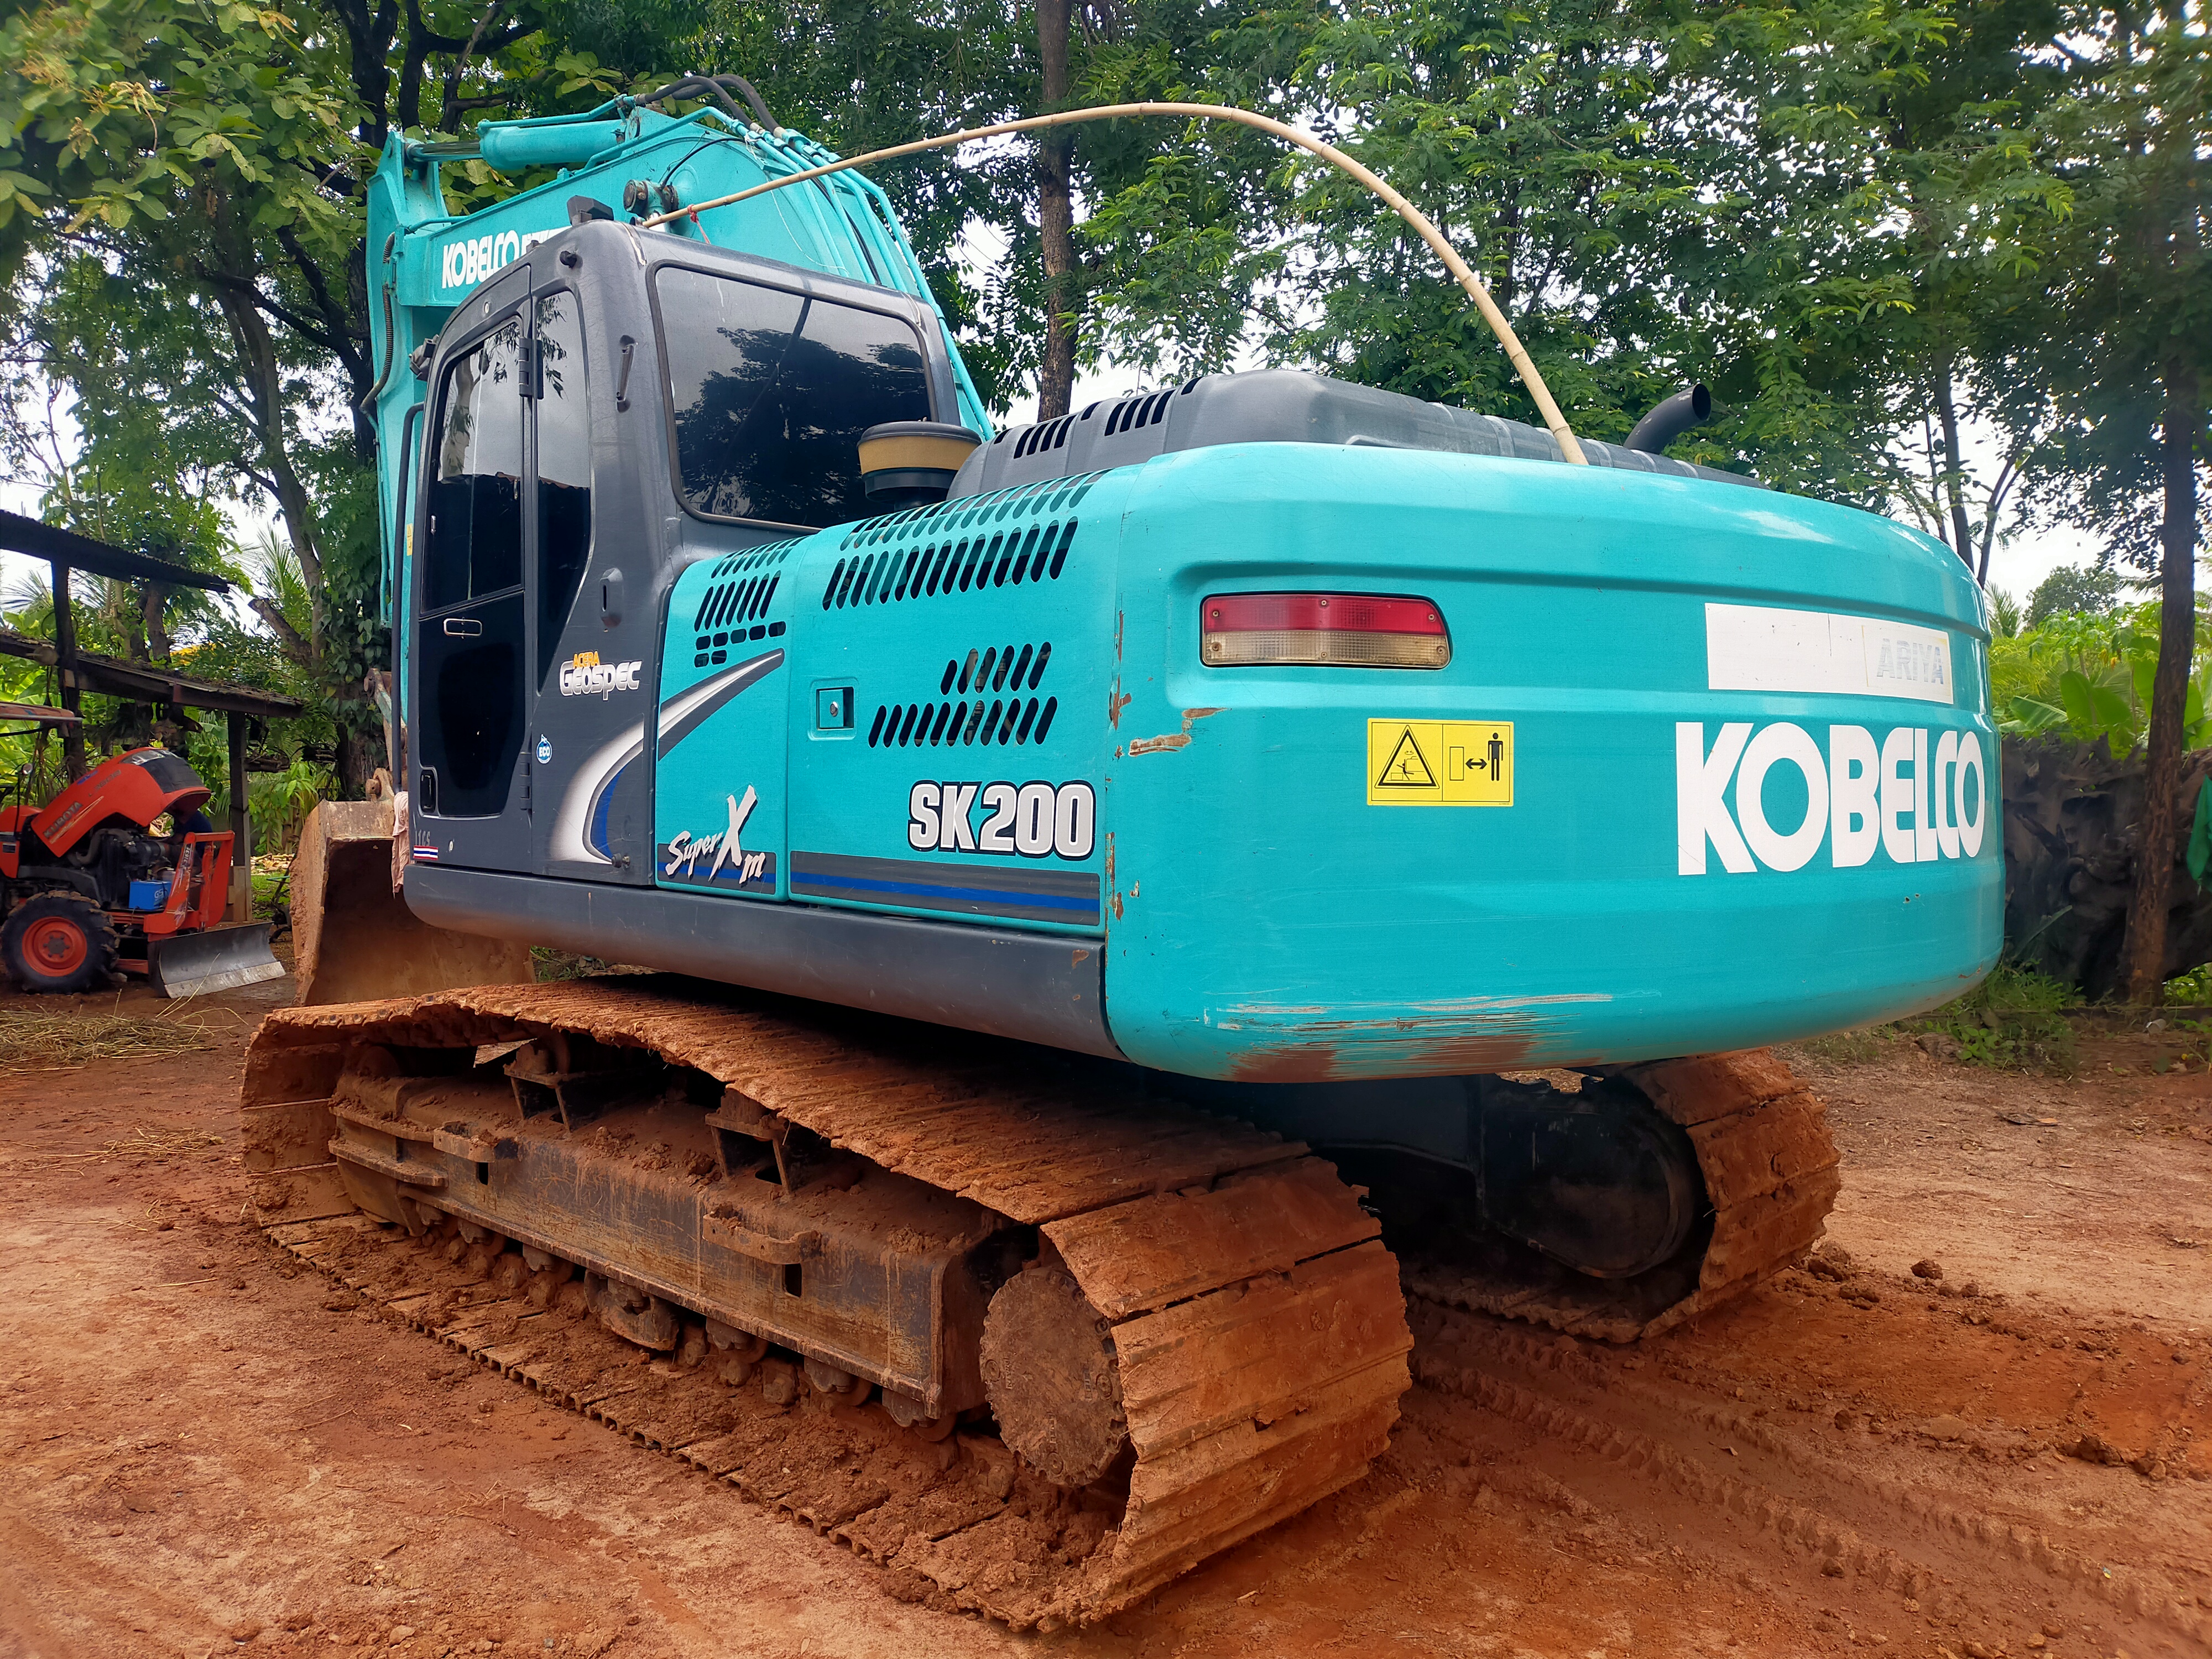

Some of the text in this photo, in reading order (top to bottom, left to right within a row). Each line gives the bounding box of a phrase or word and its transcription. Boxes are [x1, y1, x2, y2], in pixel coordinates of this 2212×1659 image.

[442, 230, 520, 289] KOBELCO
[573, 650, 601, 669] ACERA
[1876, 638, 1944, 685] ARIYA
[539, 746, 550, 757] ECO
[43, 801, 83, 839] KUBOTA
[907, 780, 1096, 861] SK200
[1676, 722, 1985, 875] KOBELCO
[665, 831, 724, 879] Super
